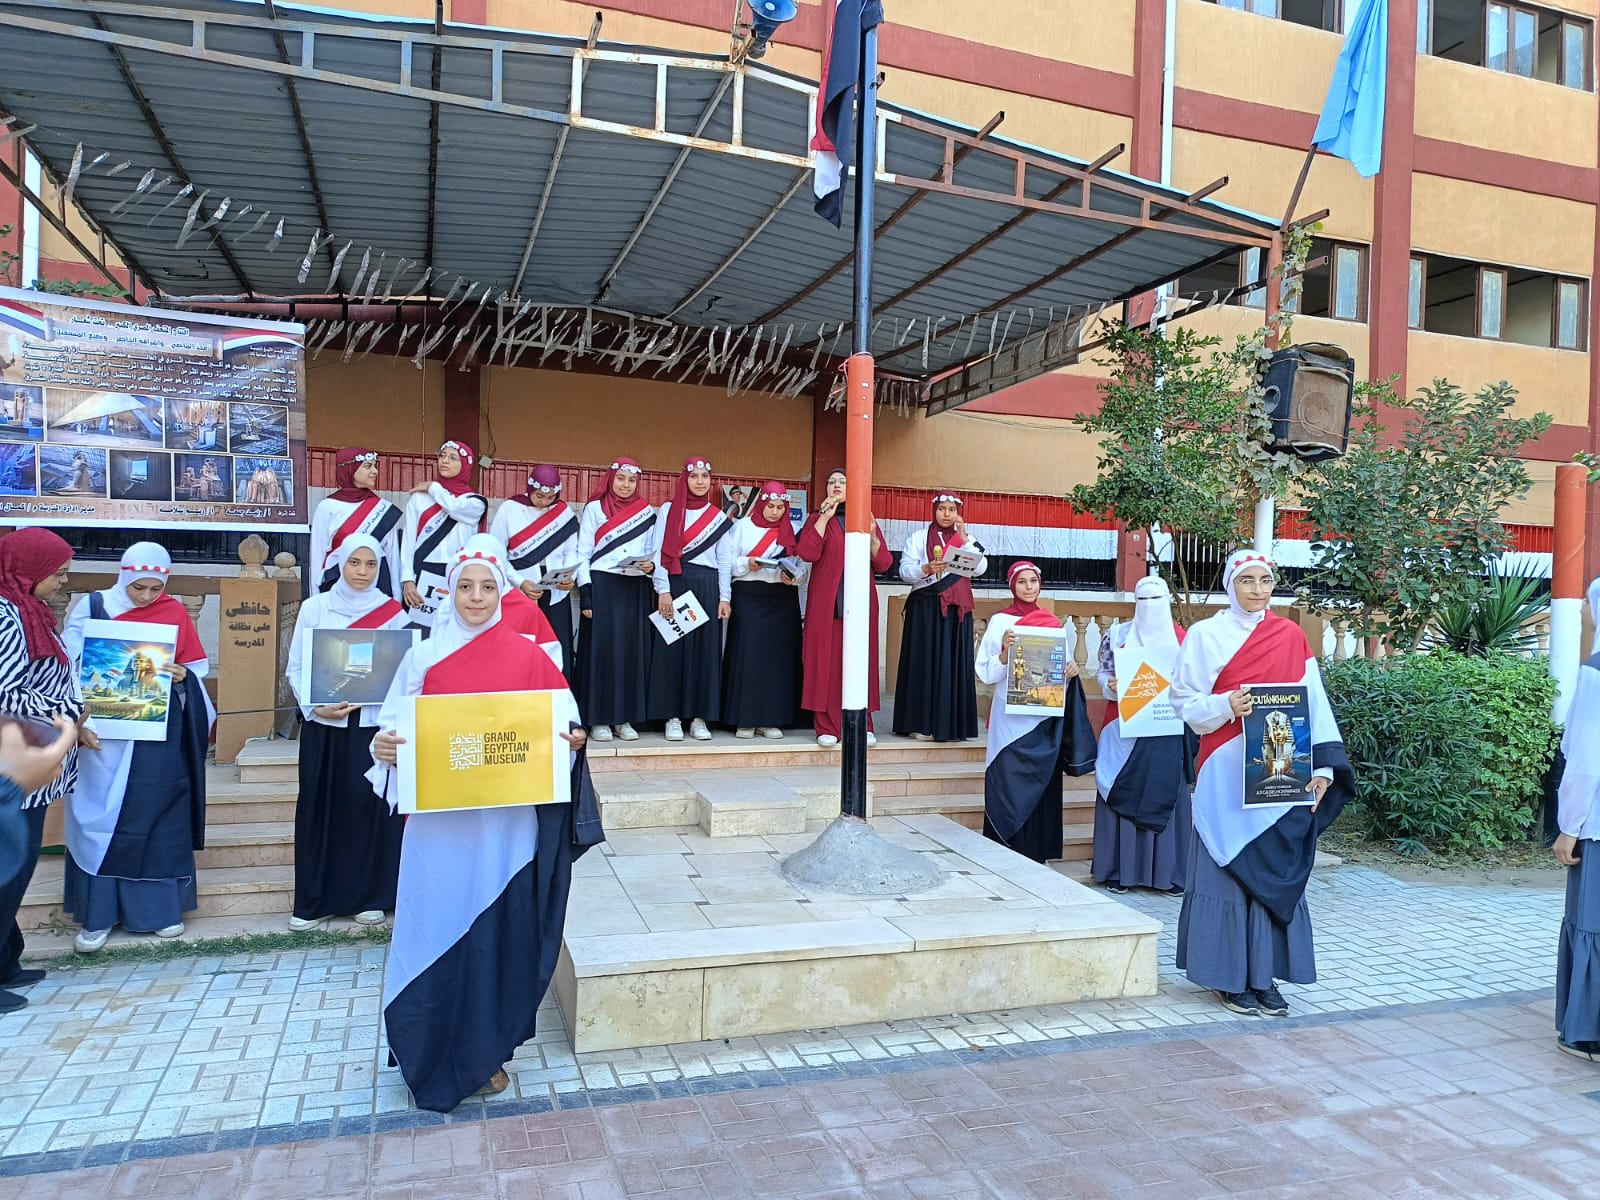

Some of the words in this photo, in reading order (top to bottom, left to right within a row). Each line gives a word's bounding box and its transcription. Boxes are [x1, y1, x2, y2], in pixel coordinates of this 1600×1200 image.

[70, 313, 92, 326] شعار
[92, 316, 105, 326] تحت
[114, 319, 132, 330] الكبير
[132, 321, 151, 332] المصري
[152, 323, 171, 333] المتحف
[38, 502, 61, 513] المدرسة
[80, 503, 95, 514] مدير
[424, 585, 435, 598] I
[234, 637, 264, 649] المدرسة
[484, 731, 517, 743] GRAND
[484, 742, 530, 754] EGYPTIAN
[484, 753, 526, 765] MUSEUM
